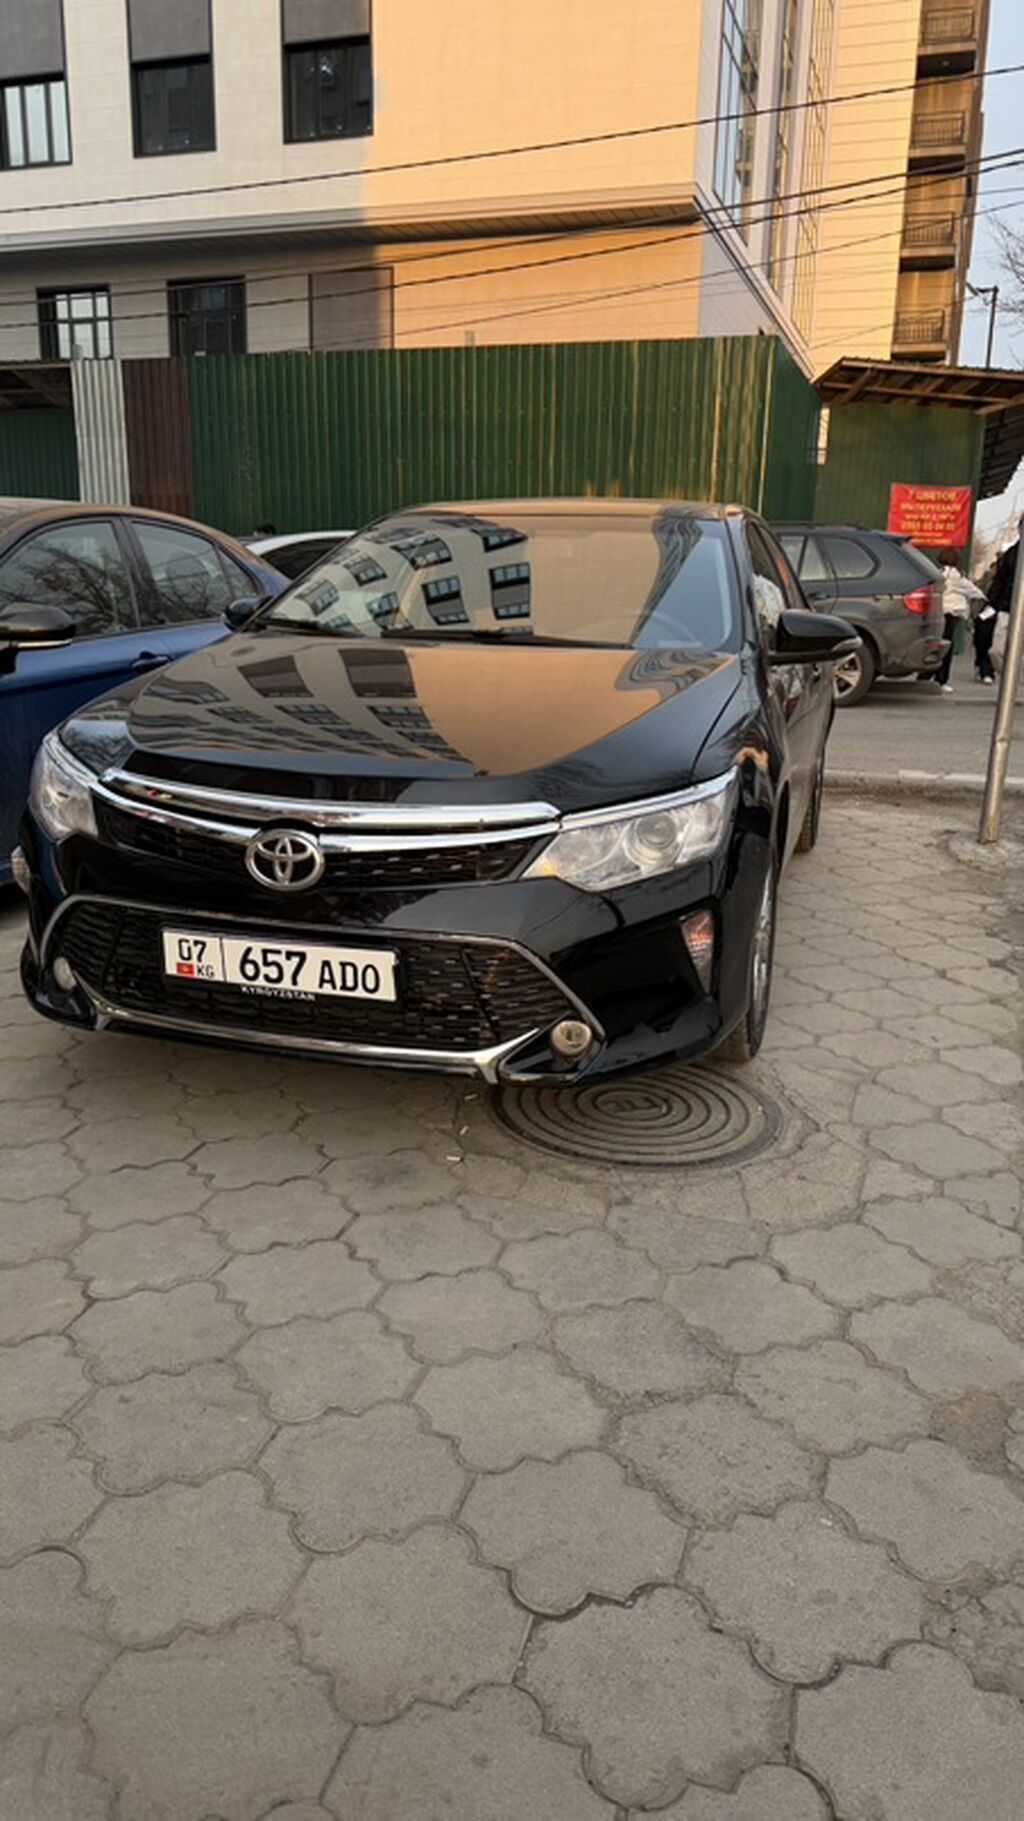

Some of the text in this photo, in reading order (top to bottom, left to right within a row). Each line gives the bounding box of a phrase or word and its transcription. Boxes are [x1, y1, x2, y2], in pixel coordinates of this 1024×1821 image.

[178, 938, 207, 962] 07
[196, 965, 215, 979] KG
[239, 946, 381, 994] 657 ADO
[240, 986, 316, 1002] KYRGYZSTAN
